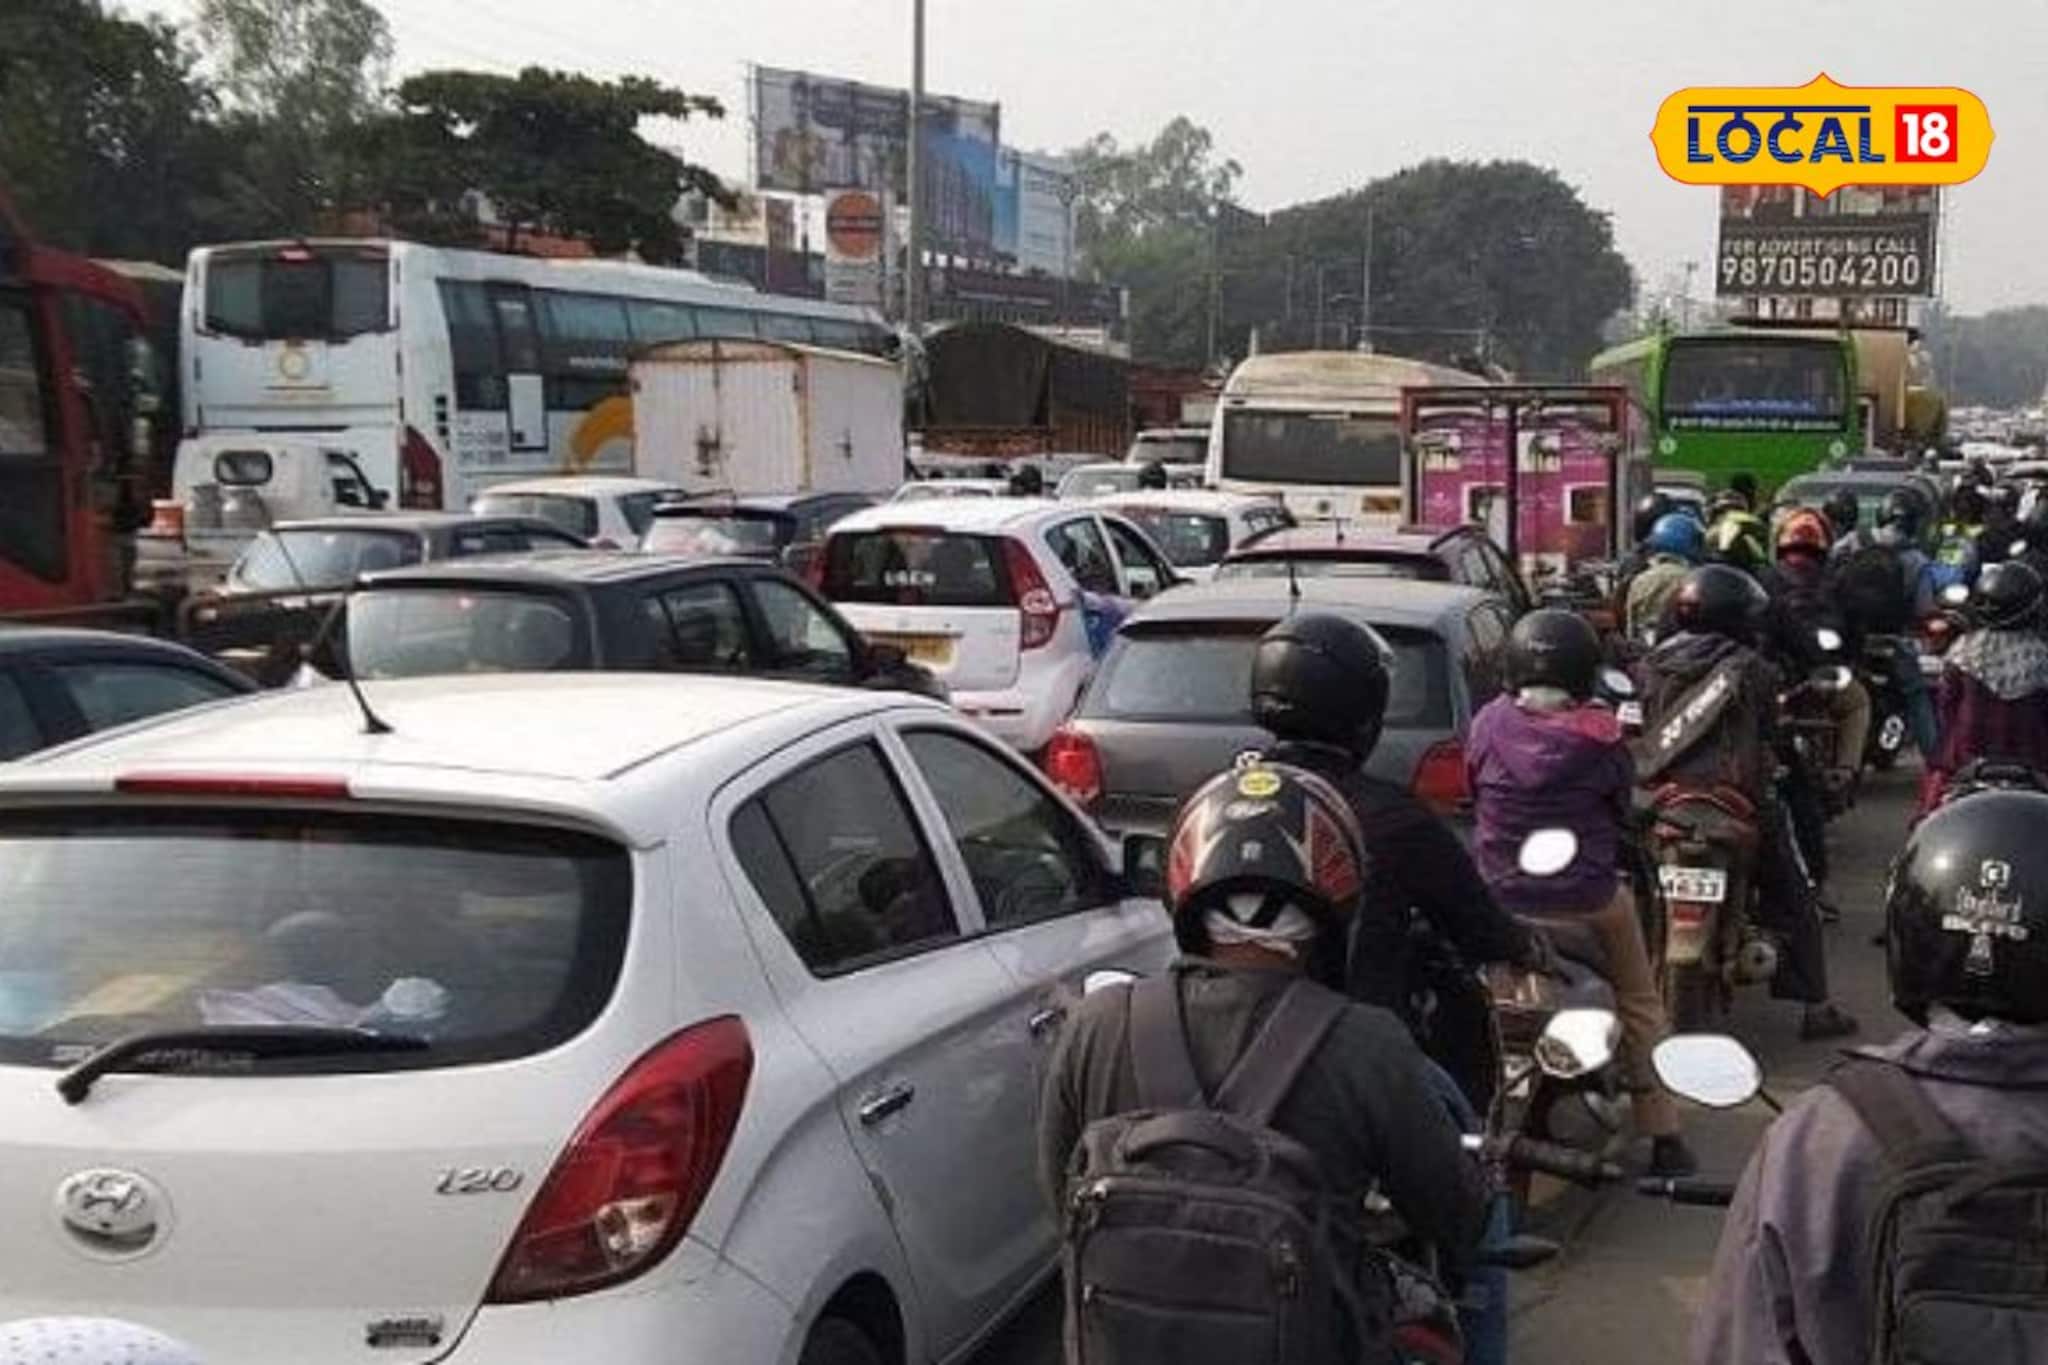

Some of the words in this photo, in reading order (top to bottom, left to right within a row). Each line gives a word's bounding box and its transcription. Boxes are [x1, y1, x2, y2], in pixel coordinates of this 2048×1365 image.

[1723, 239, 1756, 256] FOR
[1758, 238, 1872, 256] ADVERTISING
[1875, 236, 1917, 254] CALL
[1722, 254, 1921, 286] 9870504200
